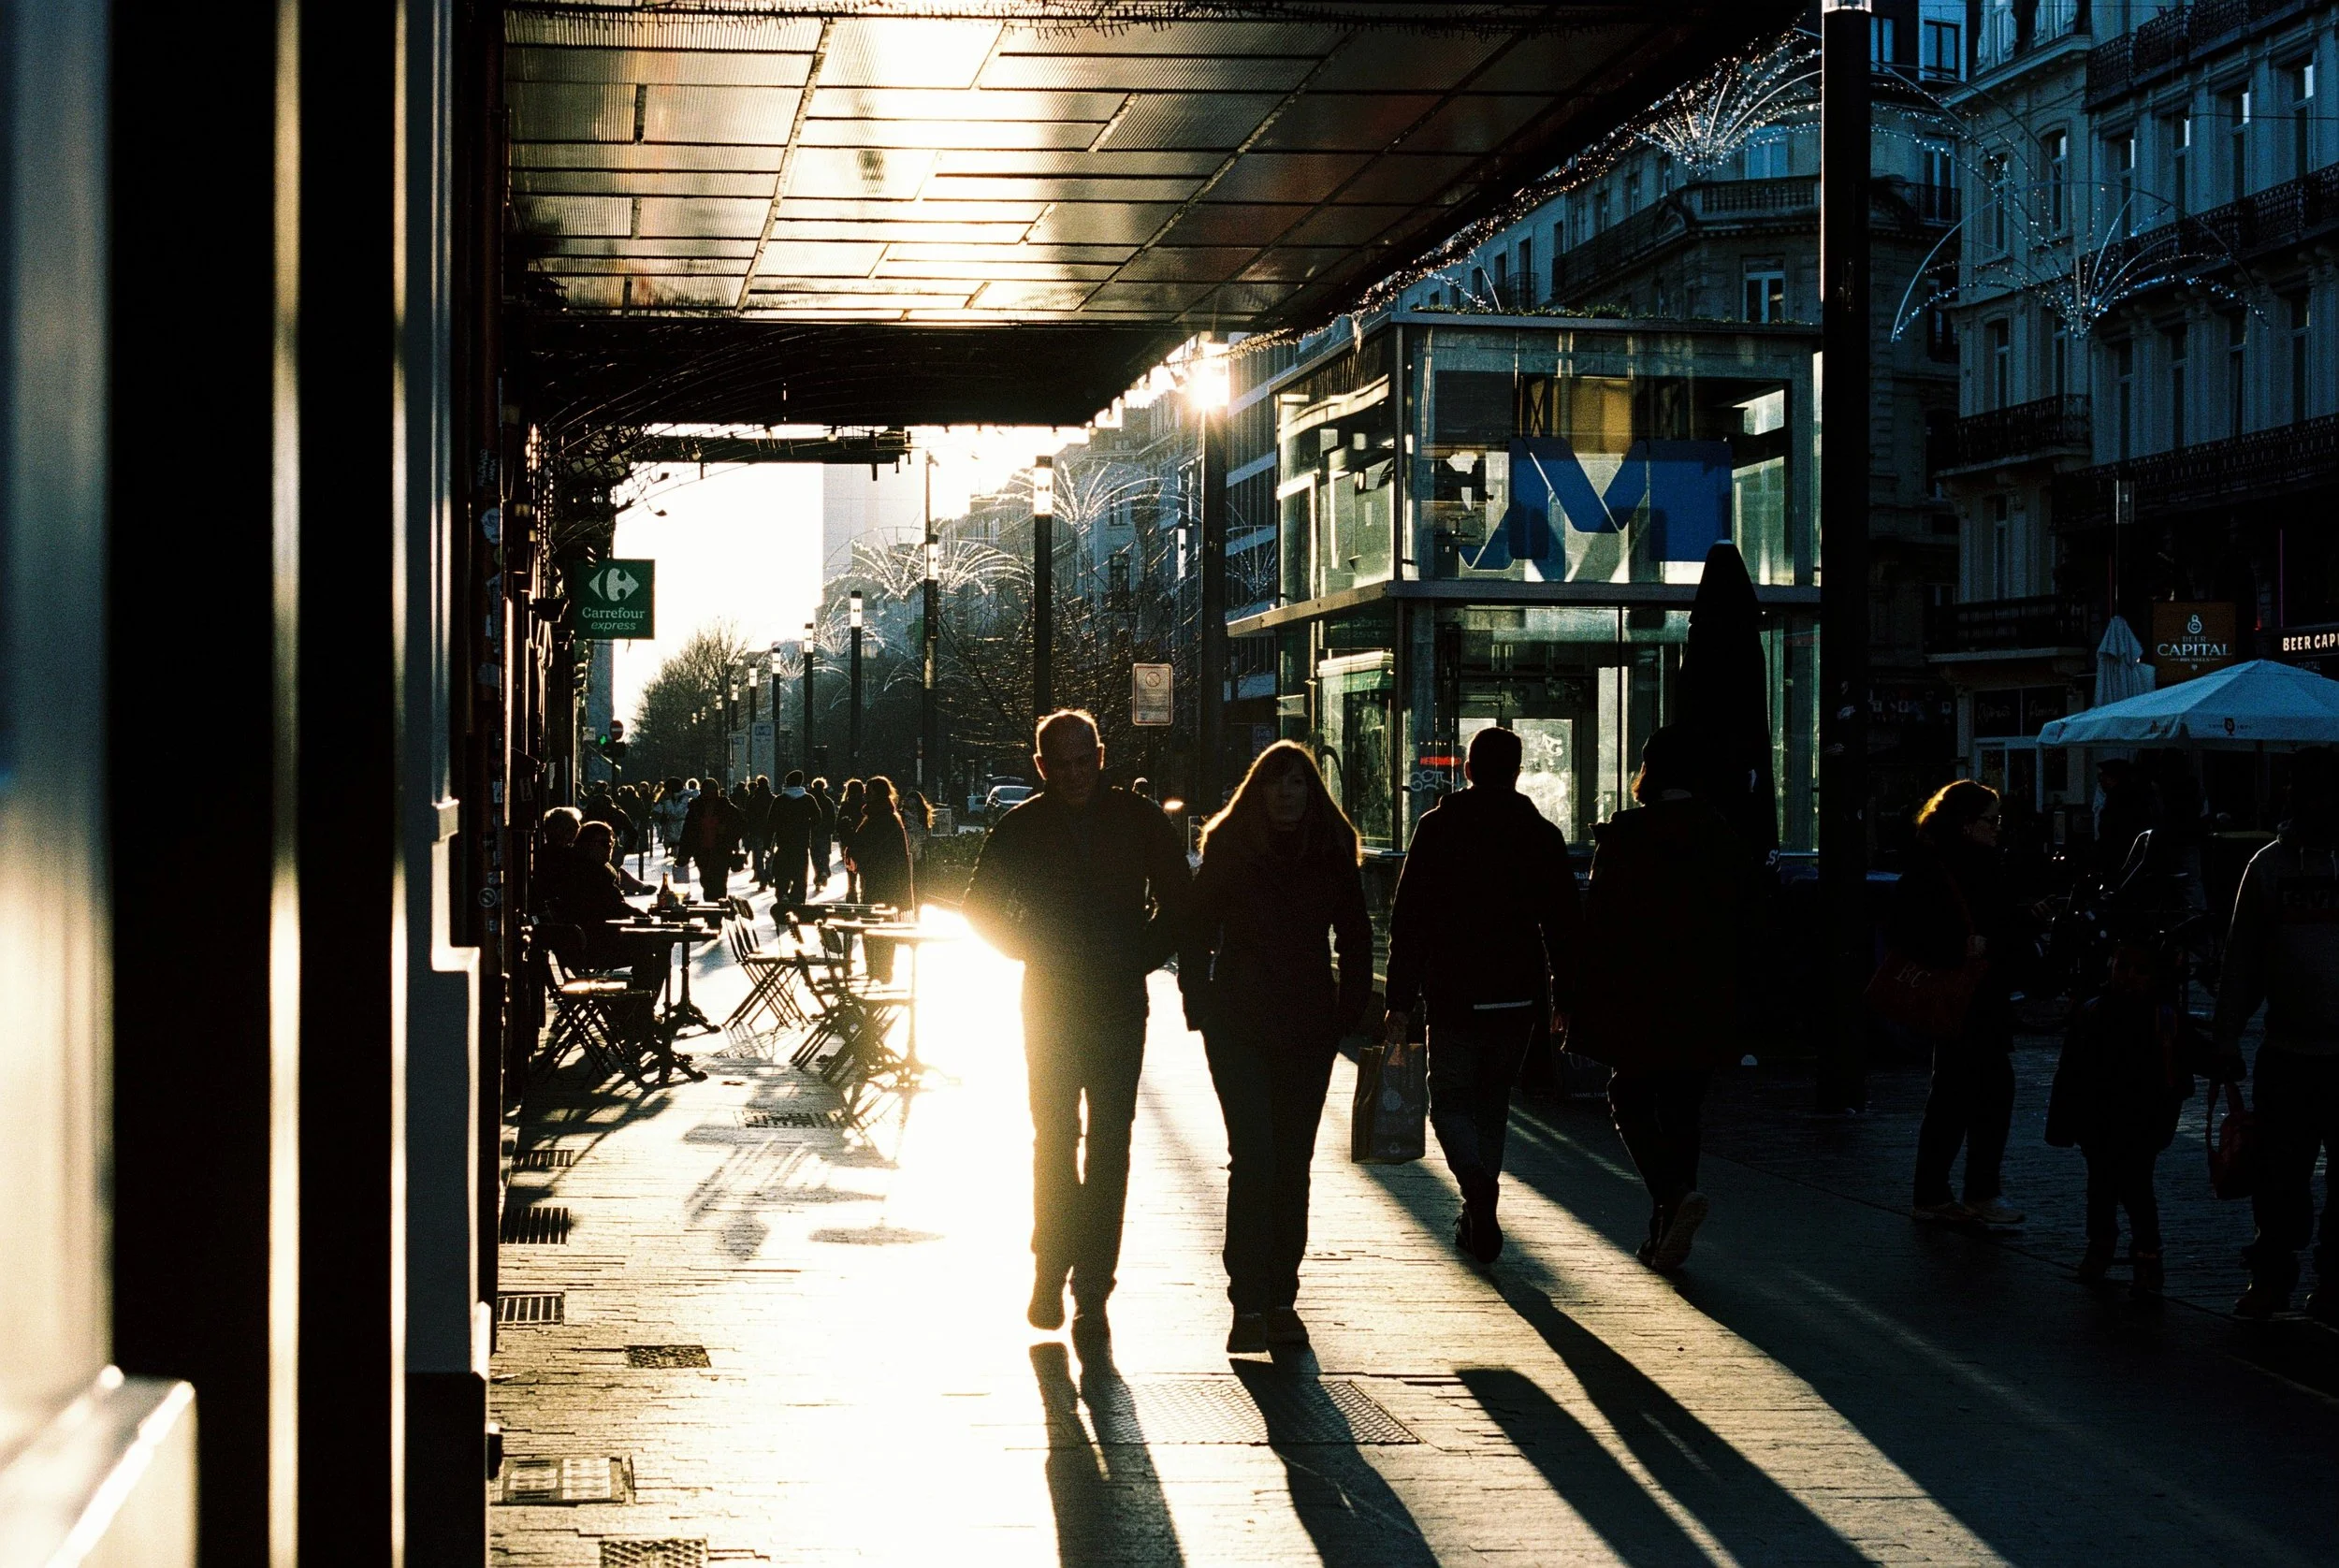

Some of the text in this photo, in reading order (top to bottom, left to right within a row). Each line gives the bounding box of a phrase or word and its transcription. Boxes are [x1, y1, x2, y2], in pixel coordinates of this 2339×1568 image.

[582, 607, 646, 618] Carrefour
[590, 621, 636, 632] express
[2157, 643, 2232, 656] CAPITAL
[2283, 635, 2312, 652] BEER
